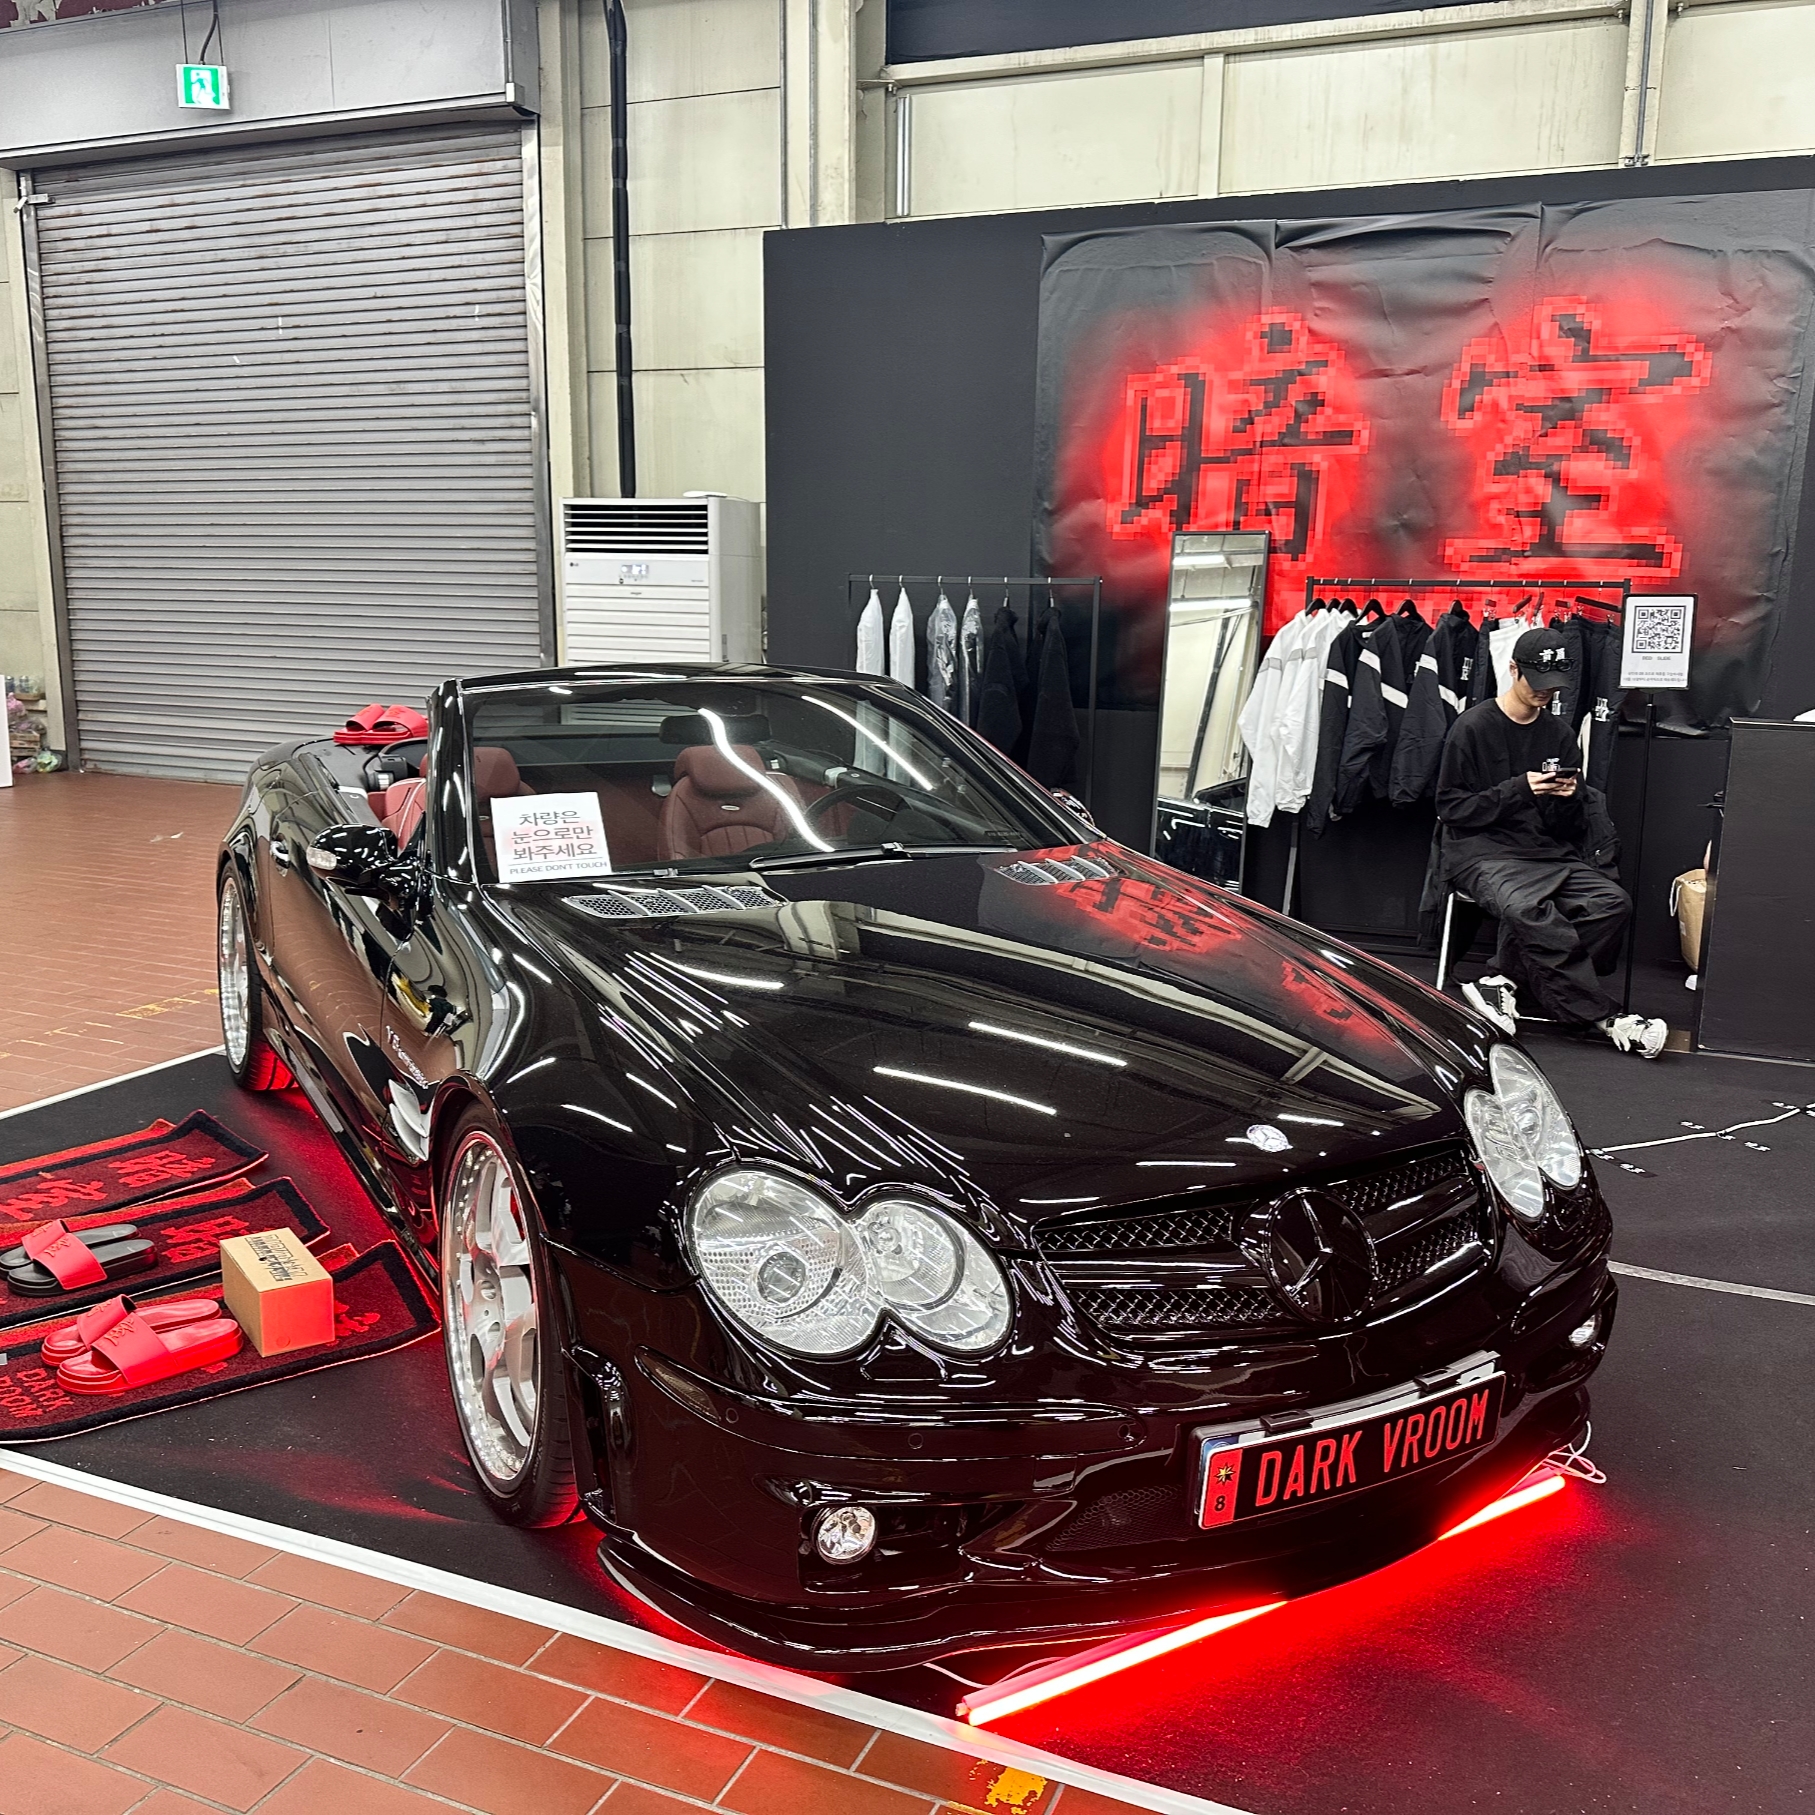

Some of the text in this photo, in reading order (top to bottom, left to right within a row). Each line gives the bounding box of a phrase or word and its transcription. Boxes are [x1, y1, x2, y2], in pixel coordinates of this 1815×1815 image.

[518, 810, 581, 827] 차량은
[511, 825, 594, 845] 눈으로만
[513, 843, 597, 861] 봐주세요
[509, 861, 608, 875] PLEASE DON'T TOUCH
[16, 1368, 75, 1412] DARK
[1255, 1389, 1490, 1508] DARK VROOM
[1213, 1495, 1227, 1513] 8
